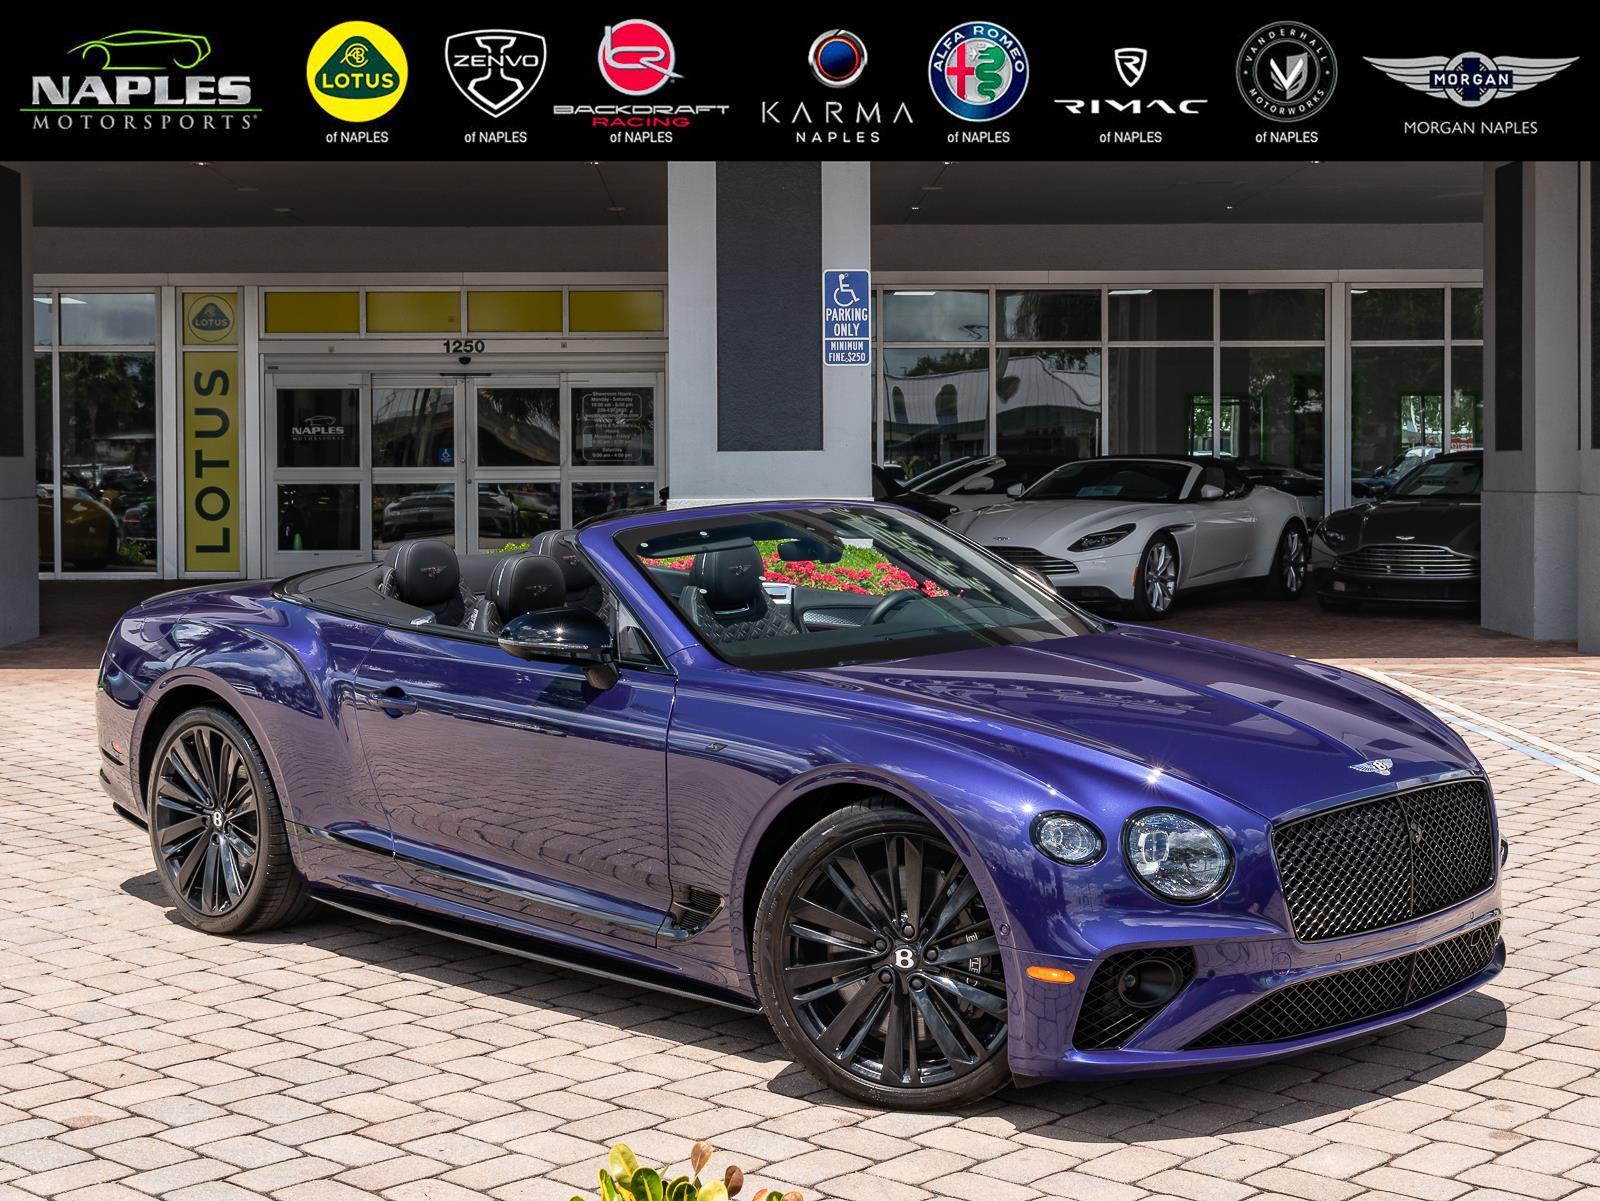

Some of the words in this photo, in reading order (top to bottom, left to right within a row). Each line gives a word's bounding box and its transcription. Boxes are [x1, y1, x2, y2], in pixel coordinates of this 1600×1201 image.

[825, 308, 868, 321] PARKING
[194, 318, 229, 327] LOTUS
[833, 323, 860, 337] ONLY
[443, 340, 486, 353] 1250
[830, 341, 864, 351] MINIMUM
[291, 426, 345, 435] NAPLES
[194, 369, 231, 553] LOTUS
[895, 948, 915, 969] B
